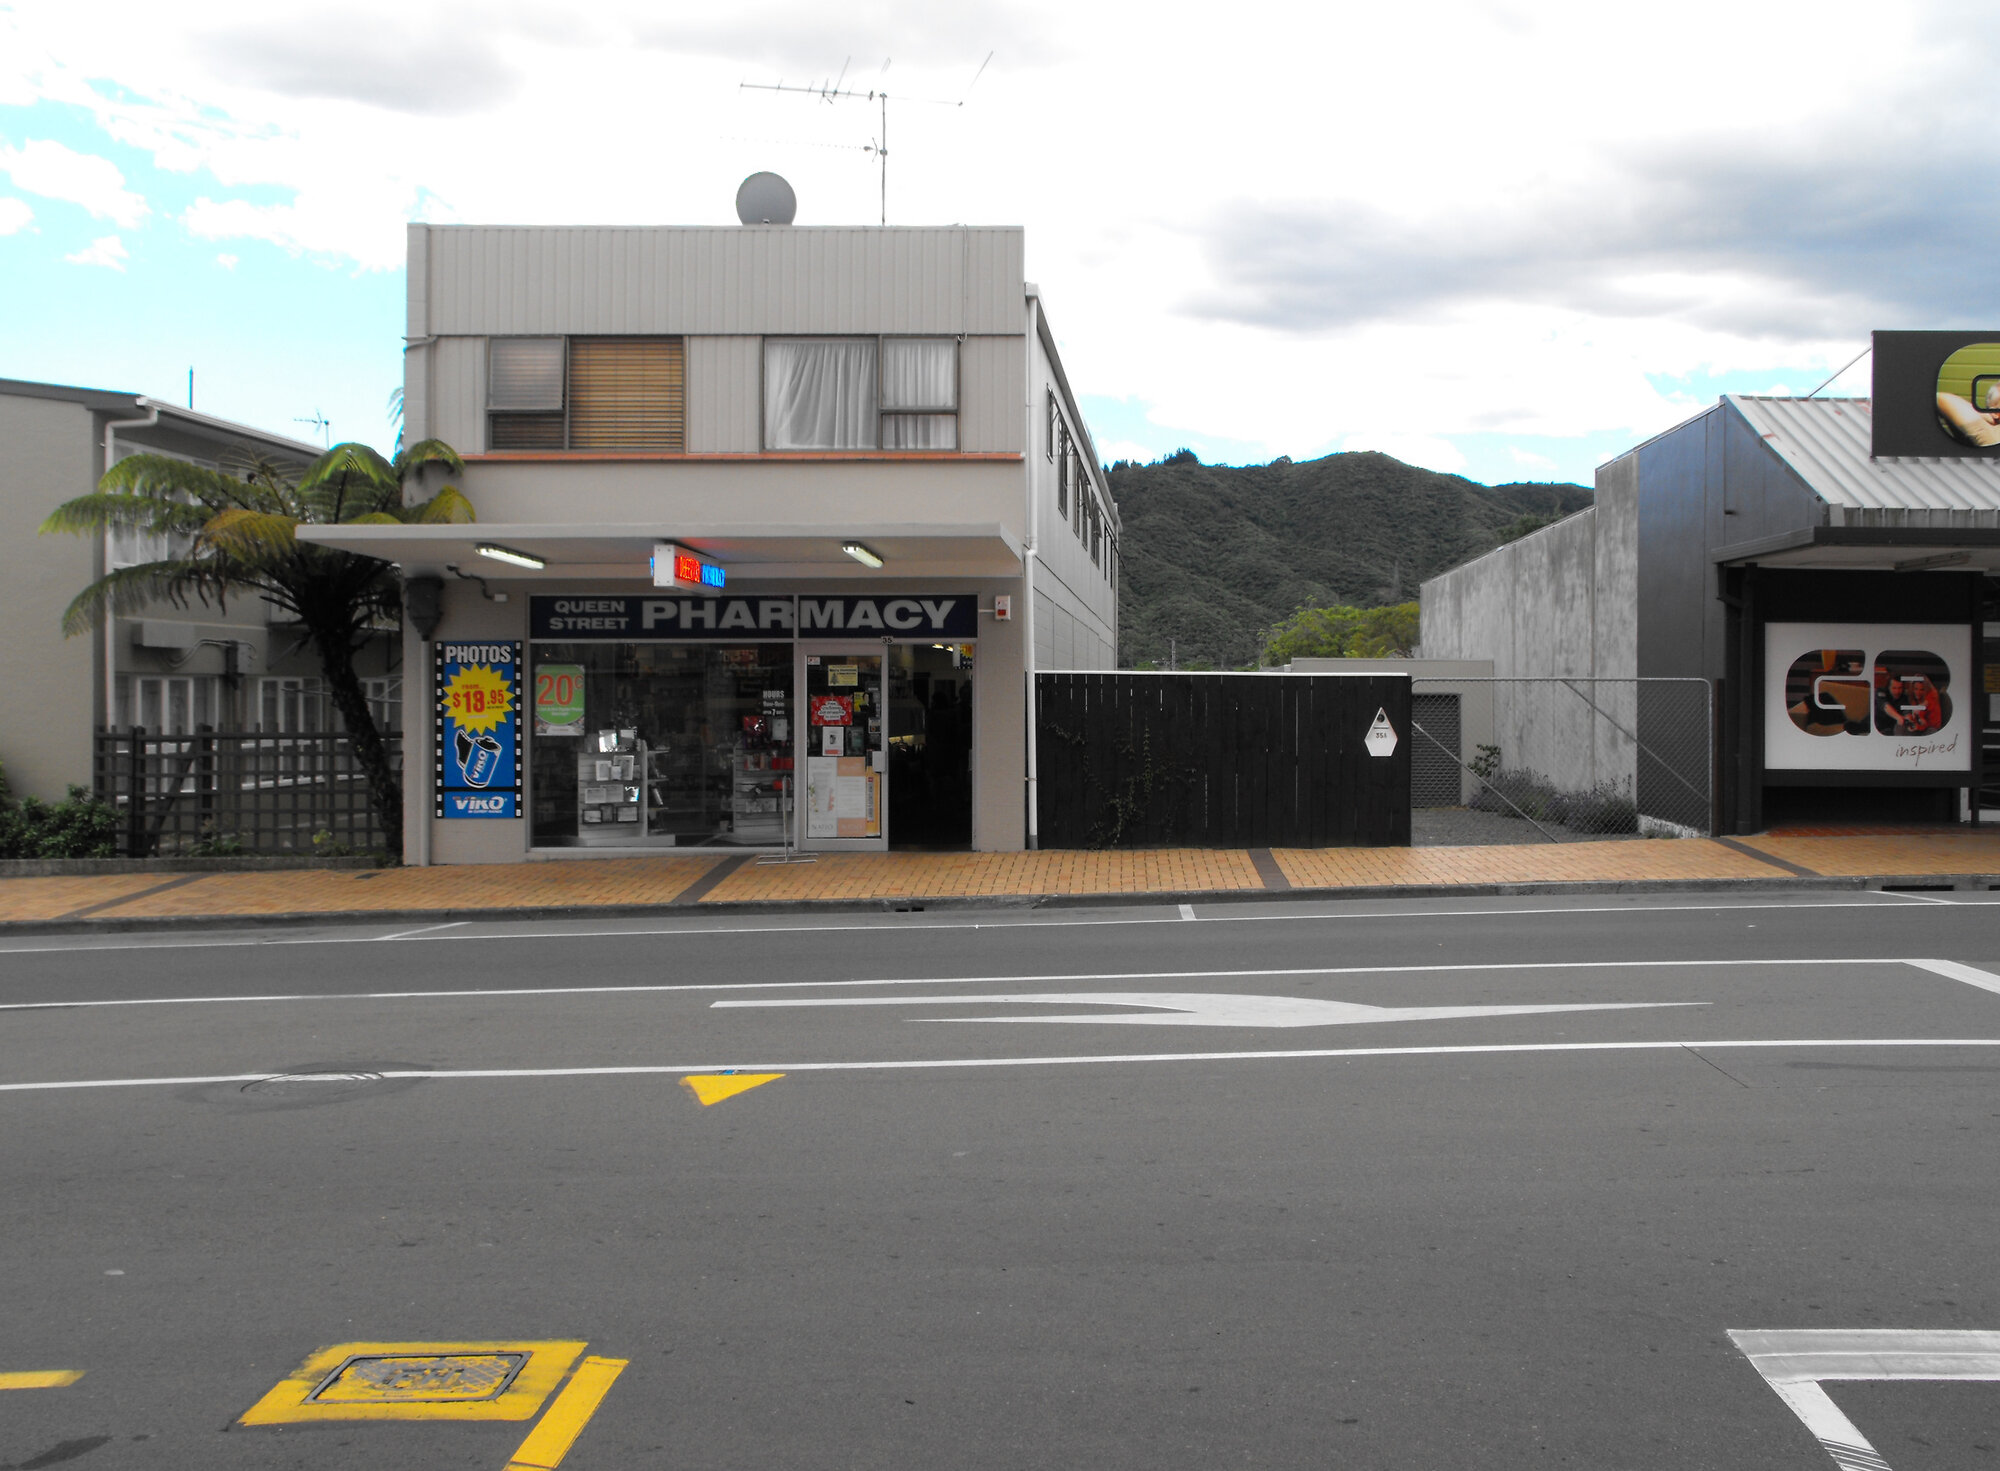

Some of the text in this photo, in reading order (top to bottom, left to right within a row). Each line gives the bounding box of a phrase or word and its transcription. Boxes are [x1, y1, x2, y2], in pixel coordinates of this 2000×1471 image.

[554, 600, 625, 615] QUEEN
[642, 600, 957, 631] PHARMACY
[549, 616, 630, 631] STREET
[445, 645, 512, 664] PHOTOS
[762, 690, 785, 699] HOURS
[1786, 650, 1954, 737] GB
[1895, 732, 1959, 767] inspired
